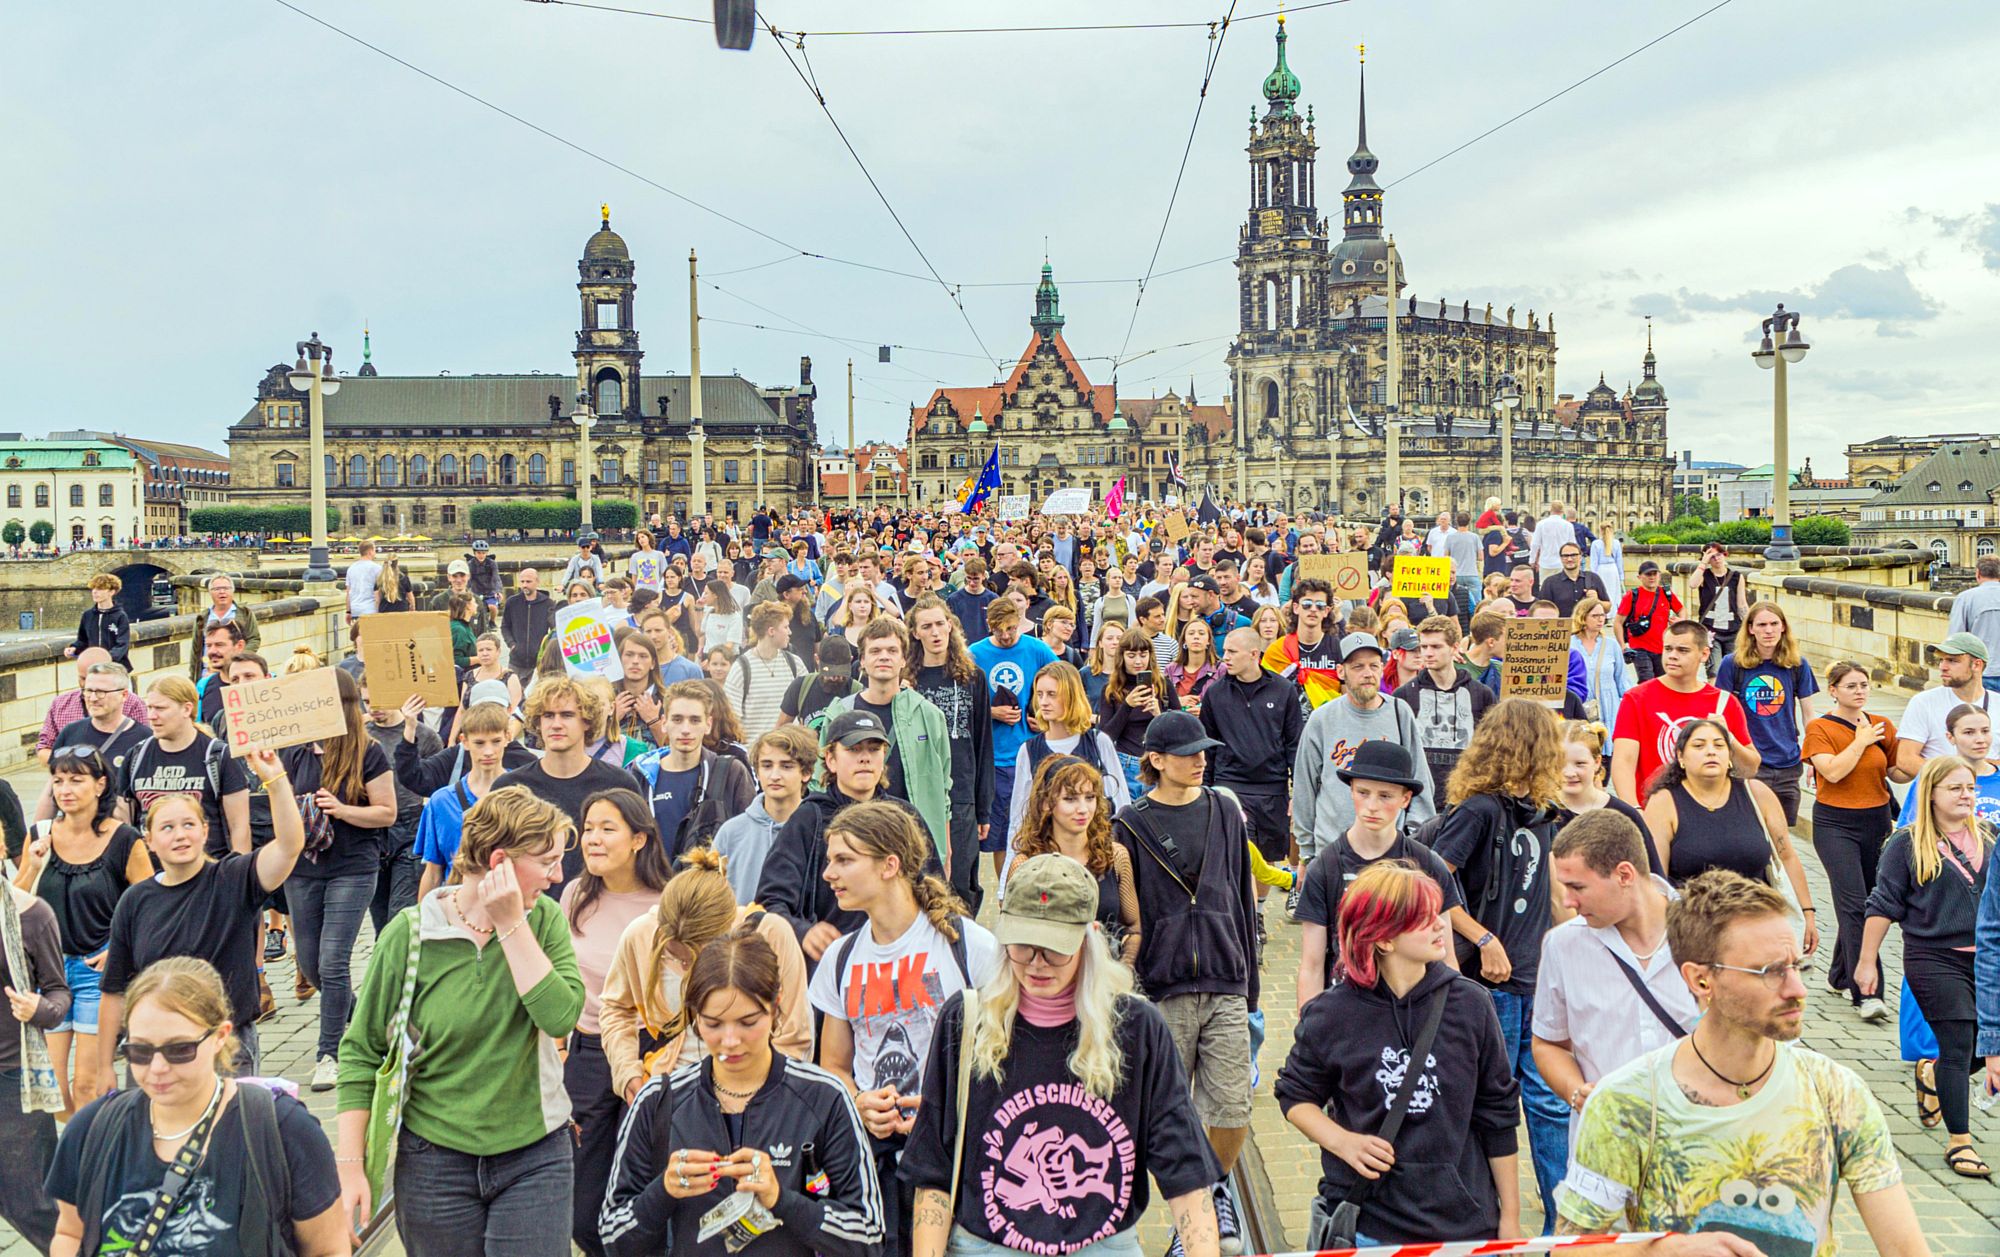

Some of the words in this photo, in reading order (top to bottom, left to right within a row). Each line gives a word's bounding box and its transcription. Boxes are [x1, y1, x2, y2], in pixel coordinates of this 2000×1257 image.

[1401, 566, 1421, 575] FUCK
[1425, 566, 1441, 576] THE
[1397, 581, 1448, 592] PATRIARCHY
[562, 623, 608, 649] STOPPT
[1508, 628, 1532, 640] Rosen
[1551, 629, 1569, 640] ROT
[1506, 642, 1538, 652] Veilchen
[1548, 642, 1569, 652] BLAU
[1299, 655, 1335, 669] itbulls
[1547, 655, 1558, 663] ist
[1505, 674, 1563, 685] TOLERANZ
[227, 686, 282, 709] Alles
[1531, 685, 1562, 696] schlau
[229, 696, 334, 728] Faschistische
[236, 722, 300, 746] Deppen
[153, 765, 187, 778] ACID
[135, 776, 206, 791] MAMMOTH
[847, 951, 936, 1018] INK
[993, 1088, 1036, 1129] DREI
[1034, 1082, 1115, 1129] SCHÜSSE
[1105, 1116, 1130, 1143] IN
[1116, 1139, 1136, 1175] DIE
[980, 1165, 1008, 1234] BOOM.
